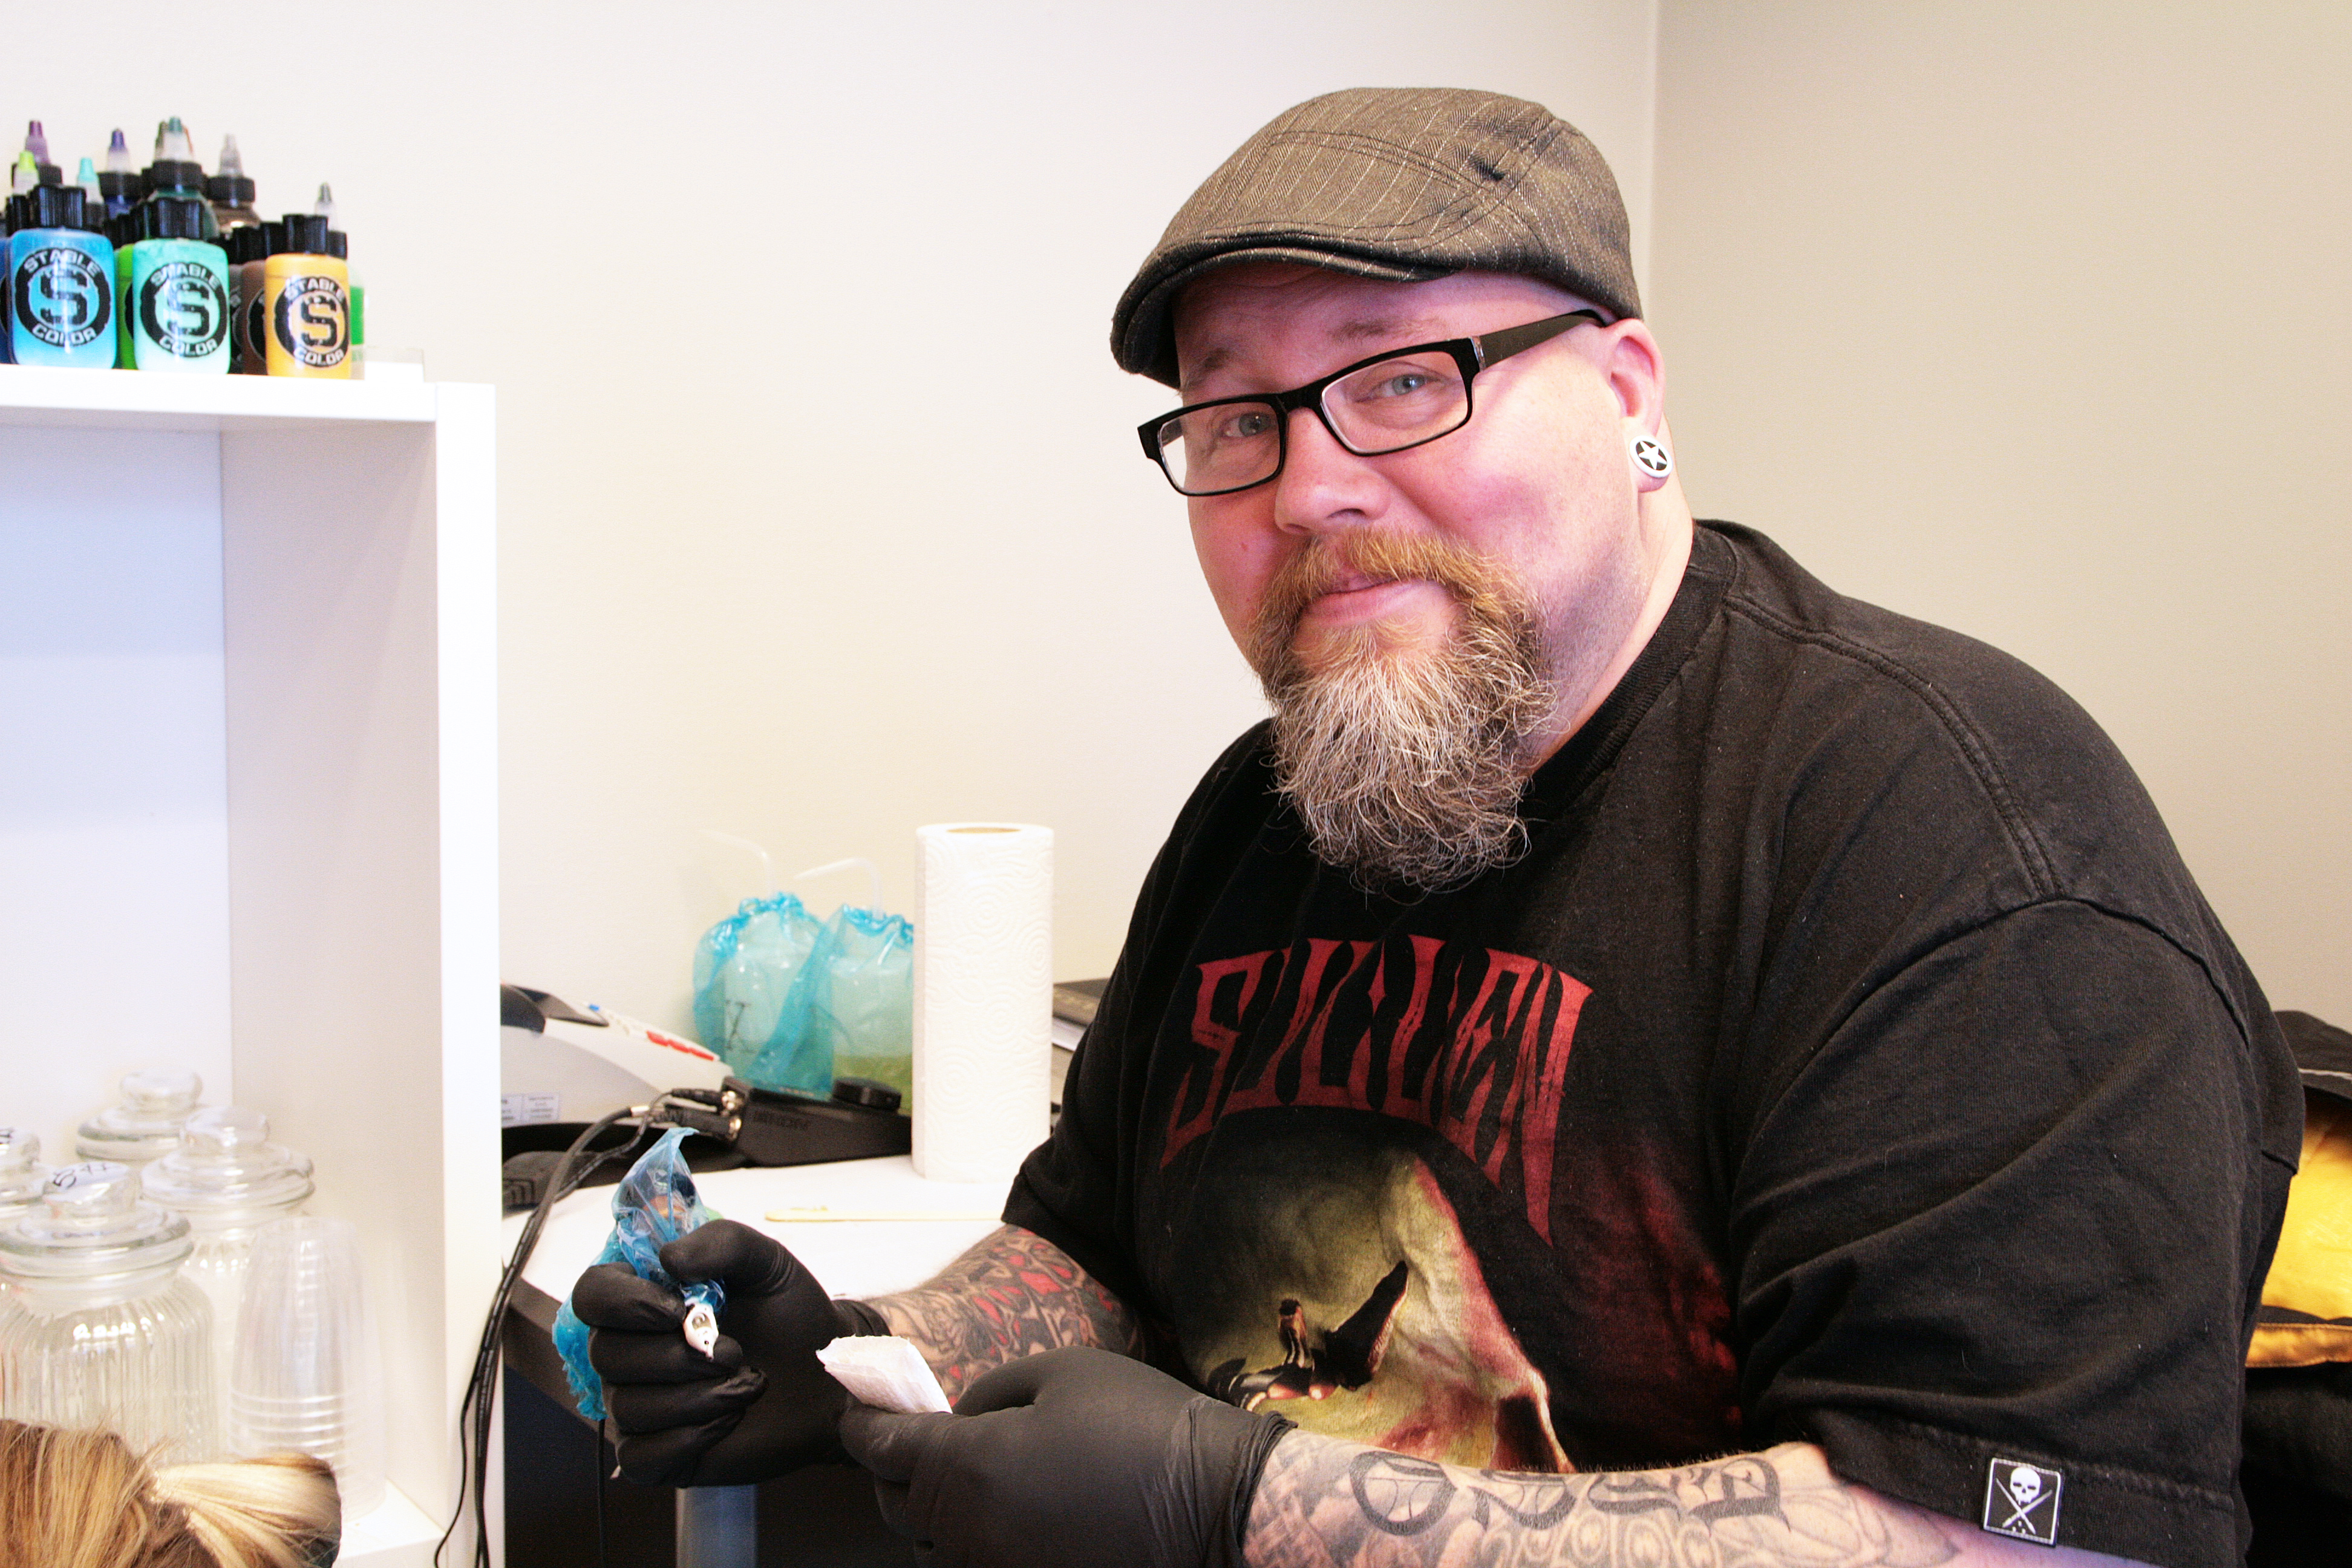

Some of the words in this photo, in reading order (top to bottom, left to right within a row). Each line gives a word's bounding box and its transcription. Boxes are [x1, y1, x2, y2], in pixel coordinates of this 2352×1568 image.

[24, 249, 101, 277] STABLE
[151, 263, 220, 290] STABLE
[40, 270, 88, 325] S
[285, 277, 345, 301] STABLE
[168, 281, 209, 336] S
[301, 295, 337, 346] S
[32, 323, 96, 344] COLOR
[159, 335, 218, 356] COLOR
[294, 346, 345, 365] COLOR
